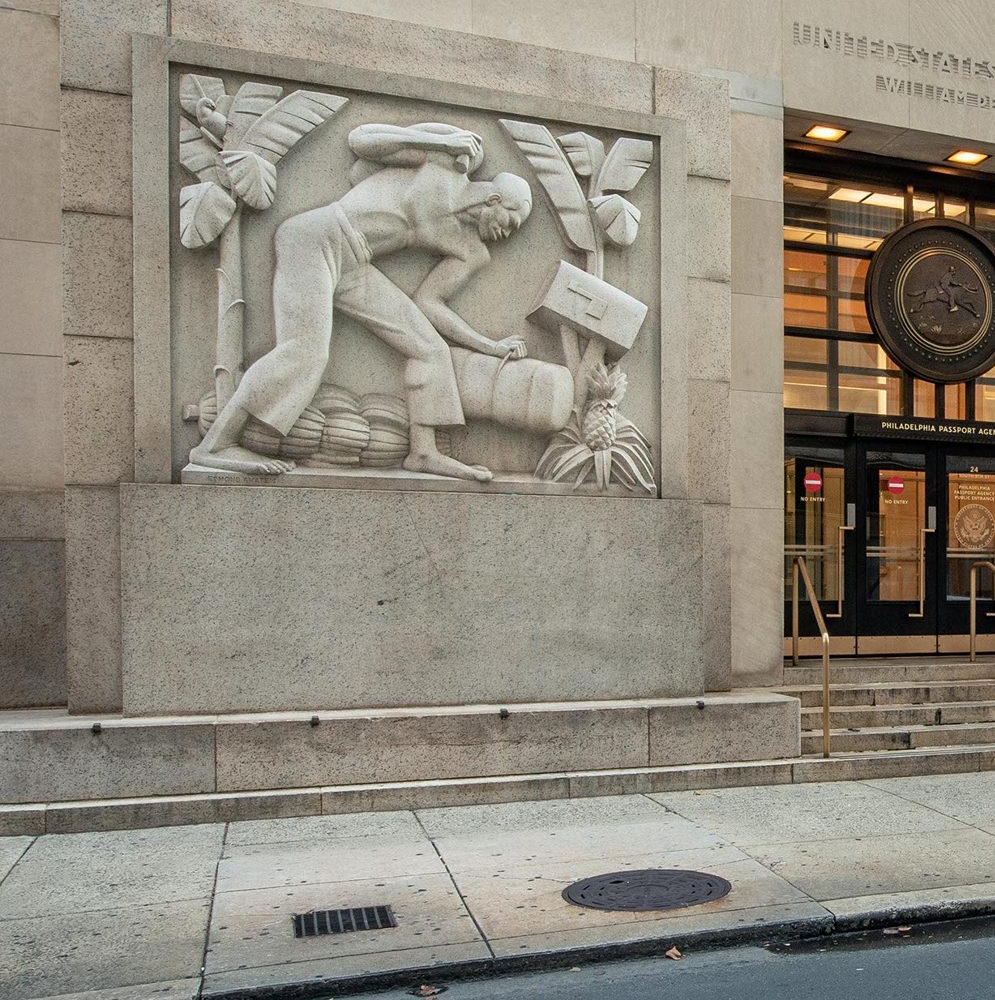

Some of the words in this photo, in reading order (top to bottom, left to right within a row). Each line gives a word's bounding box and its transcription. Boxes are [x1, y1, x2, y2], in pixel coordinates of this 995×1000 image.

[795, 21, 900, 64] UNITED
[879, 75, 967, 106] WILLIAM
[881, 421, 936, 432] PHILADELPHIA
[938, 425, 976, 434] PASSPORT
